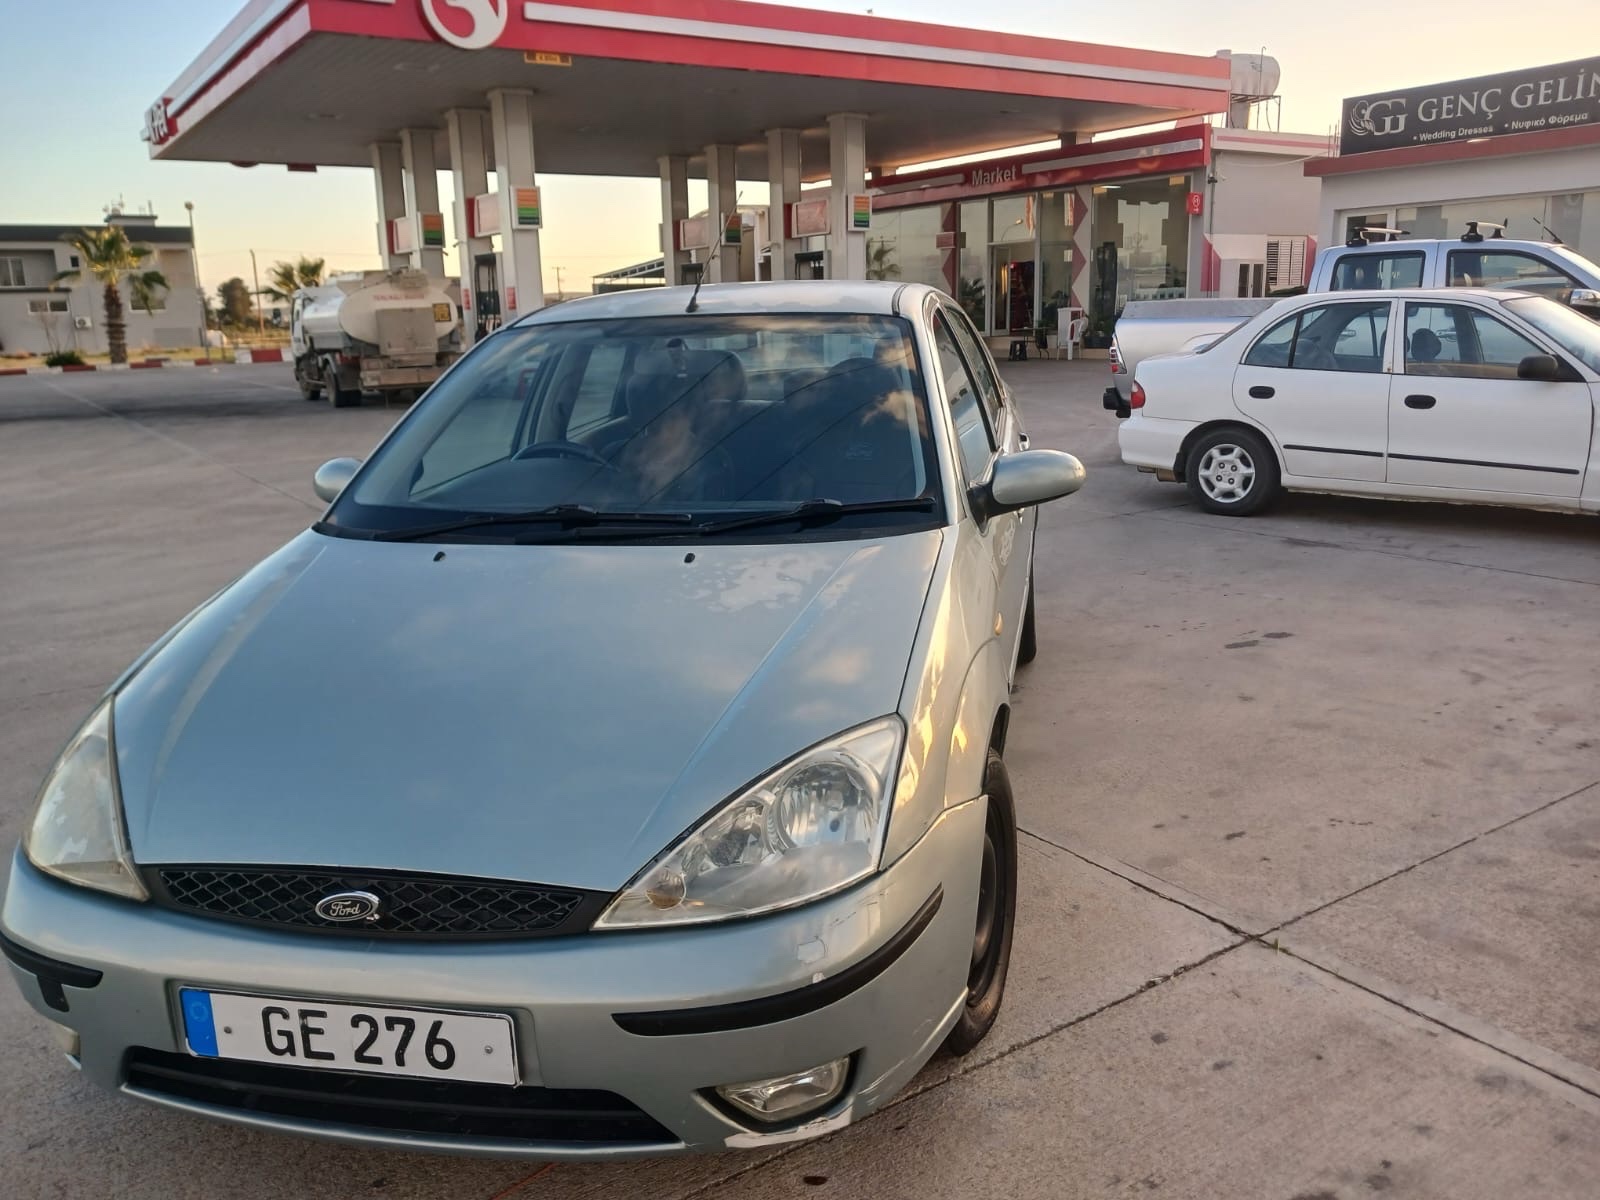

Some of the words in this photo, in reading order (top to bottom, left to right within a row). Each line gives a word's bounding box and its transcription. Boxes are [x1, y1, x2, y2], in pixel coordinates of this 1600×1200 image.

[1417, 88, 1502, 121] GENÇ
[1419, 129, 1456, 142] Wedding
[1458, 125, 1493, 137] Dresses
[972, 164, 1017, 186] Market
[329, 900, 361, 917] Ford
[260, 1005, 336, 1061] GE
[350, 1012, 456, 1071] 276
